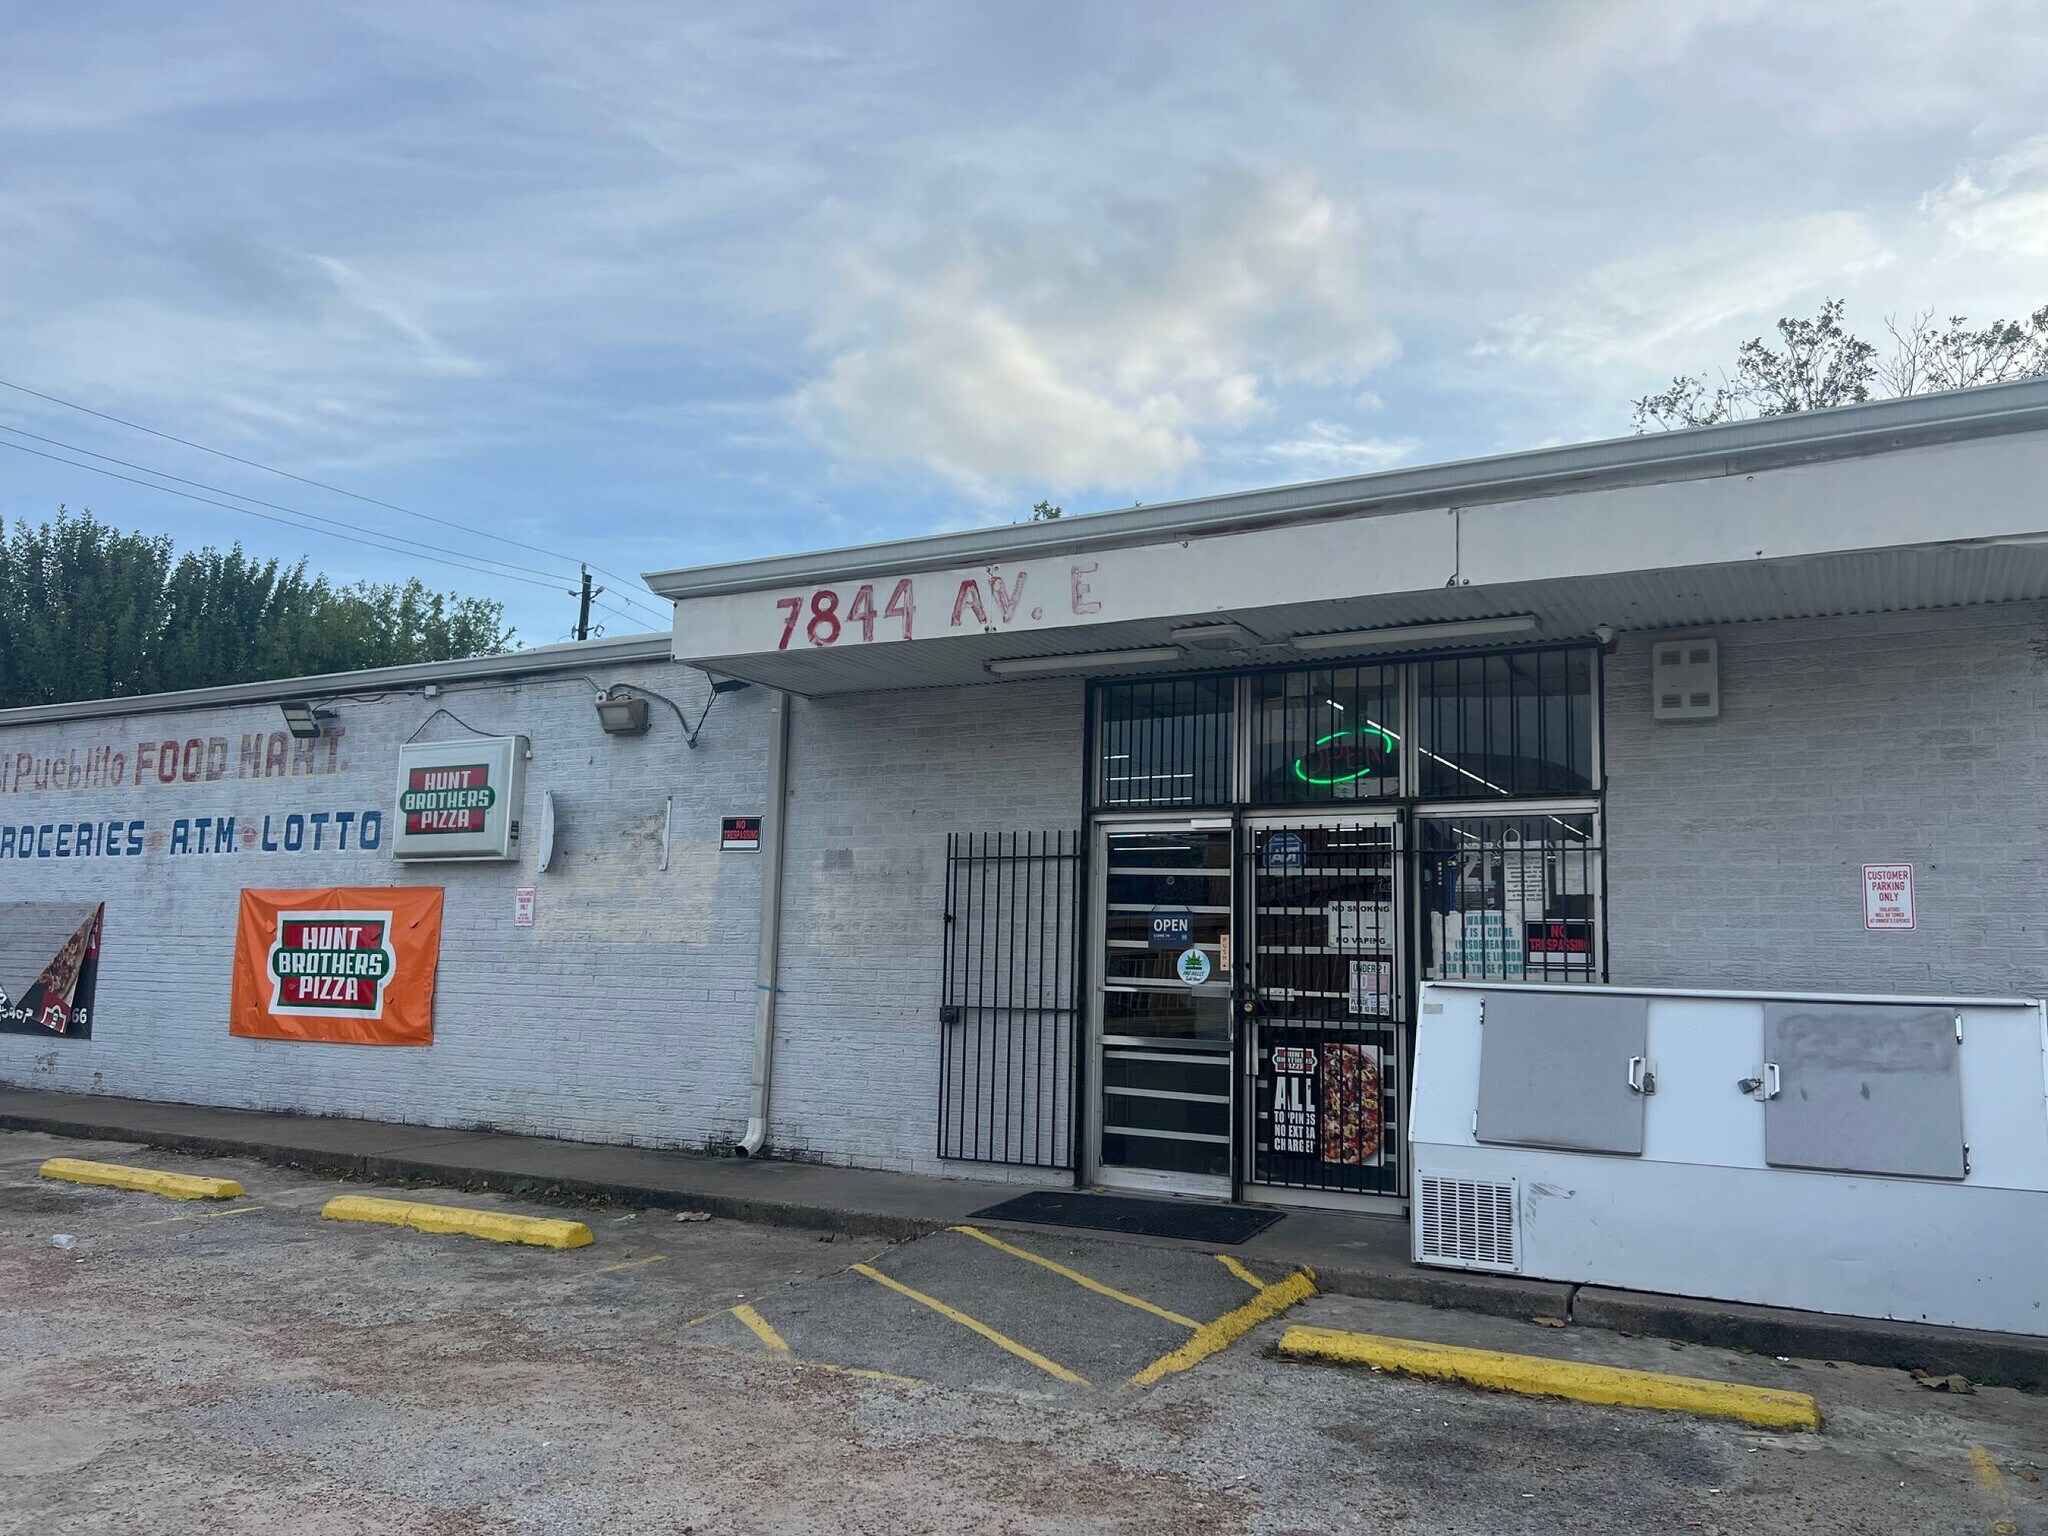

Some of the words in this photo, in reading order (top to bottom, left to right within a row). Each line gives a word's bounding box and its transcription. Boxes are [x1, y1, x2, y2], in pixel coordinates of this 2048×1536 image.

[777, 578, 916, 650] 7844
[951, 571, 1043, 627] AV.
[1071, 562, 1101, 615] E
[135, 737, 228, 785] FOOD
[425, 771, 471, 790] HUNT
[405, 790, 489, 810] BROTHERS
[421, 809, 470, 829] PIZZA
[736, 819, 746, 830] NO
[262, 811, 381, 851] LOTTO
[1867, 871, 1909, 880] CUSTOMER
[1872, 881, 1905, 891] PARKING
[1879, 892, 1898, 902] ONLY
[1153, 919, 1188, 931] OPEN
[1550, 925, 1566, 937] NO
[302, 927, 362, 950] HUNT
[279, 952, 382, 975] BROTHERS
[1472, 964, 1495, 973] THSE
[299, 976, 358, 1000] PIZZA
[1274, 1077, 1315, 1112] ALL
[1274, 1111, 1316, 1124] TOPINGS
[1274, 1124, 1286, 1137] NO
